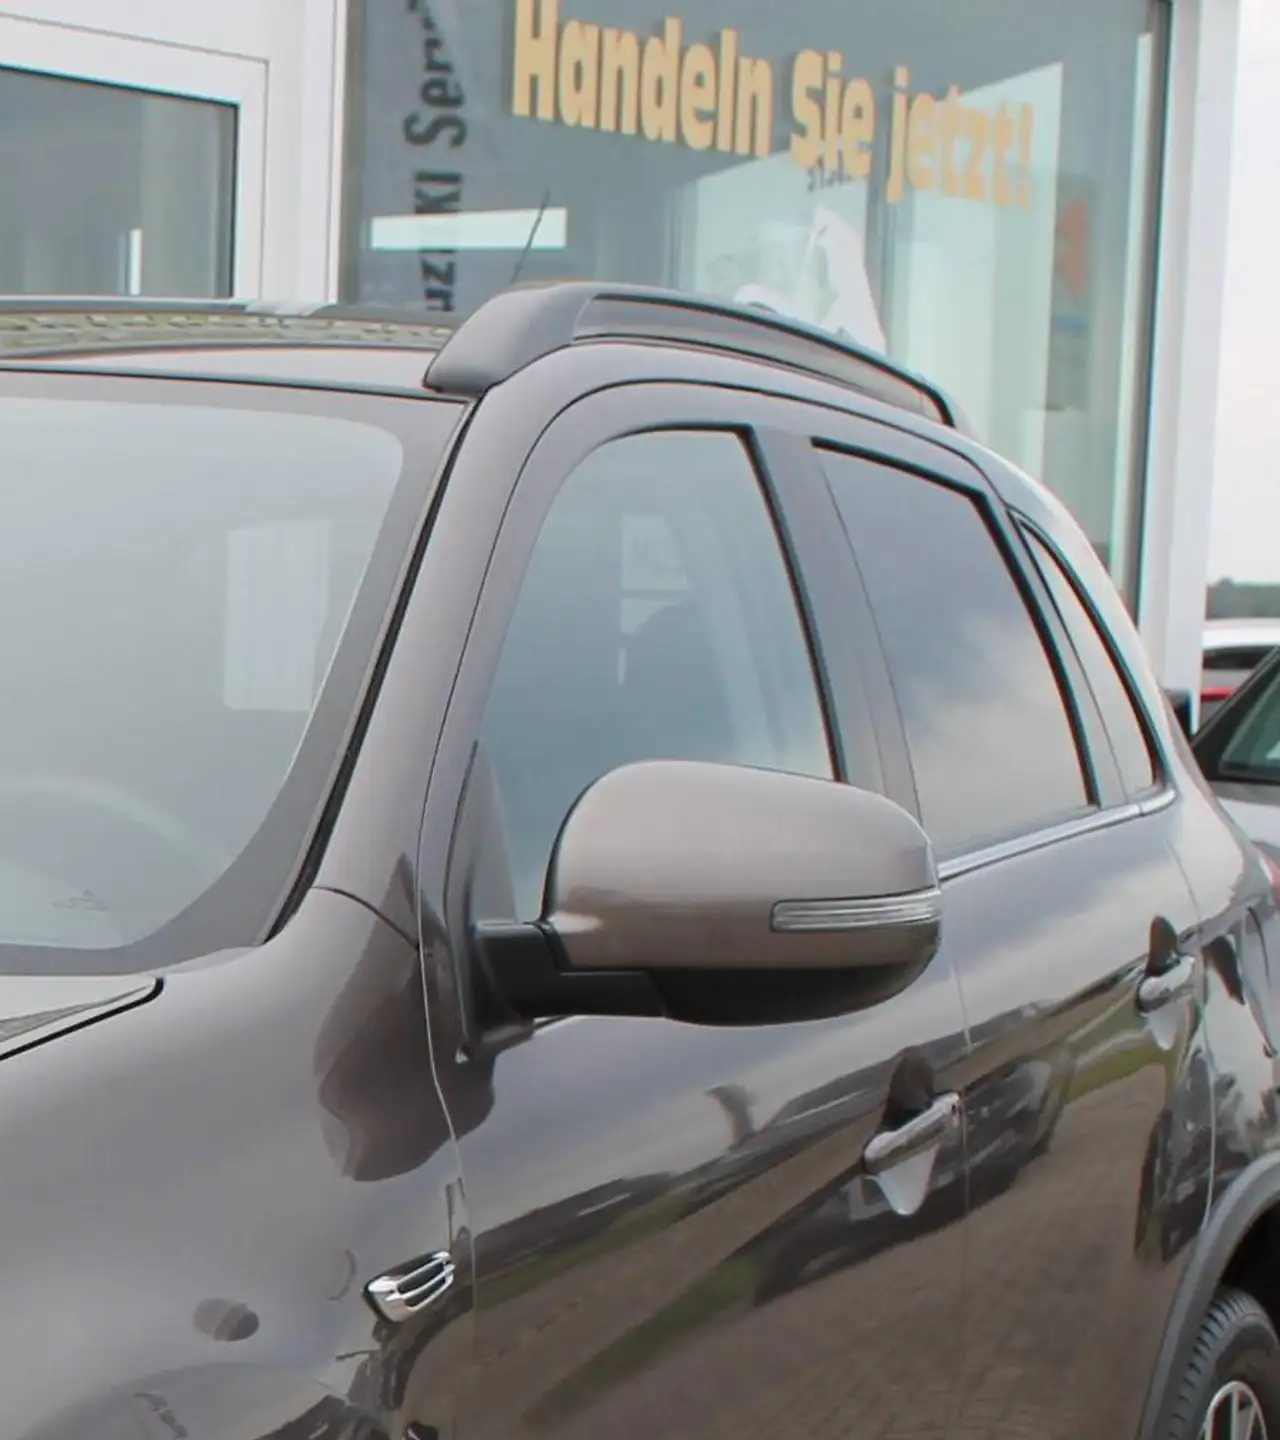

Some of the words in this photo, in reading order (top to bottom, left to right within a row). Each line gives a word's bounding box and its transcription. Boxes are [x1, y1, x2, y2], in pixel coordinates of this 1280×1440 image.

[511, 0, 774, 158] Handeln
[790, 48, 876, 179] Sie
[886, 66, 1035, 209] jetzt!
